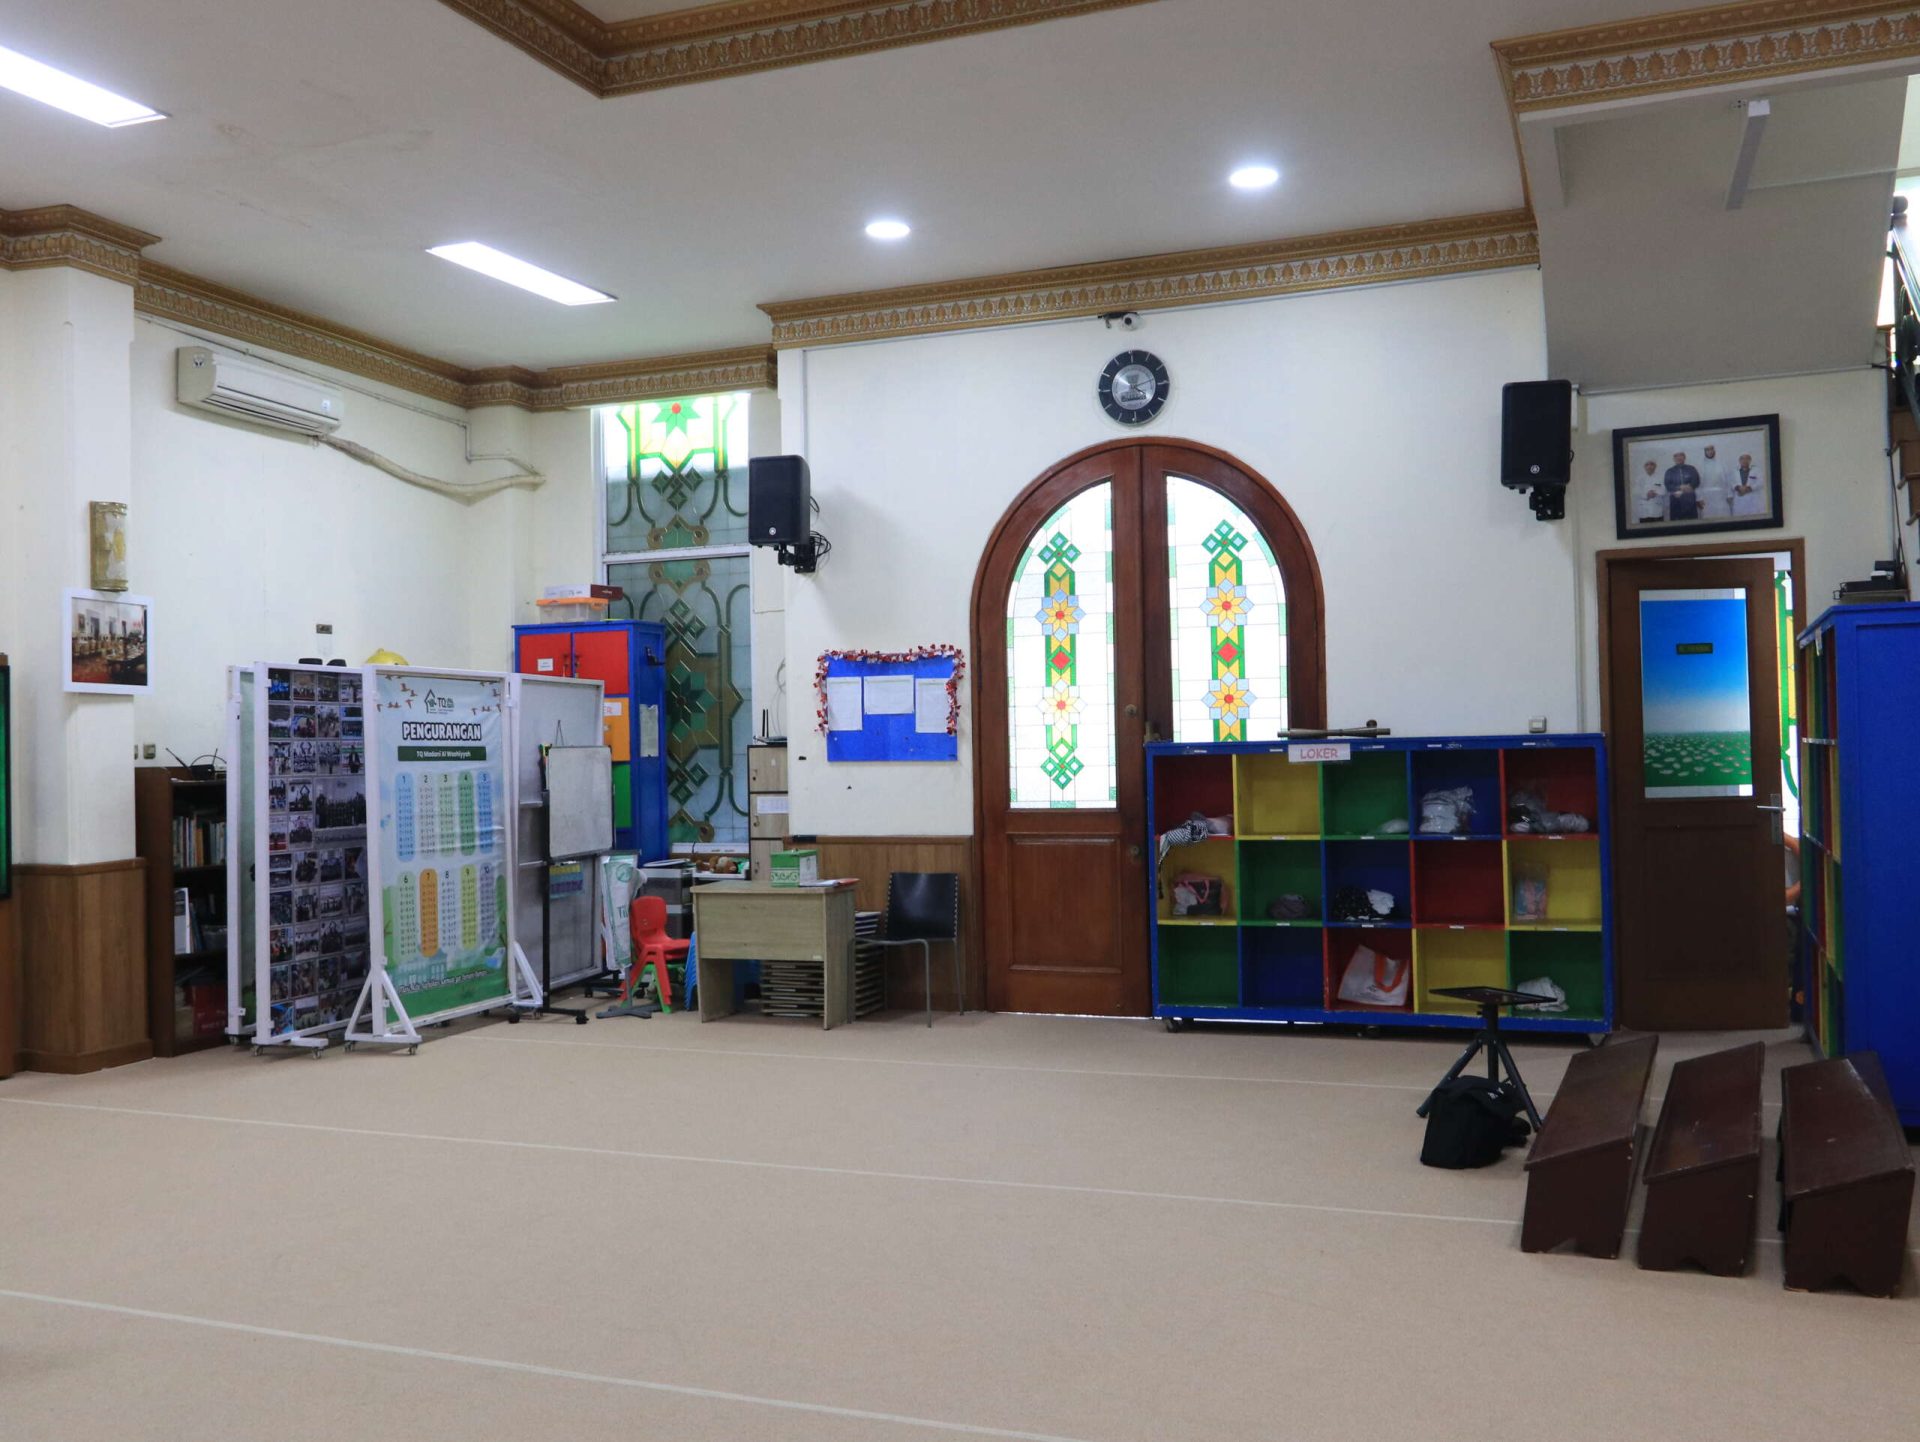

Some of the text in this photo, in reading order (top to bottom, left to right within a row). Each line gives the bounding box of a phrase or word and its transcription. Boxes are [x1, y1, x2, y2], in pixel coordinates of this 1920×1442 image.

[402, 721, 482, 741] PENGURANGAN
[416, 750, 424, 759] TQ
[1300, 747, 1338, 760] LOKER
